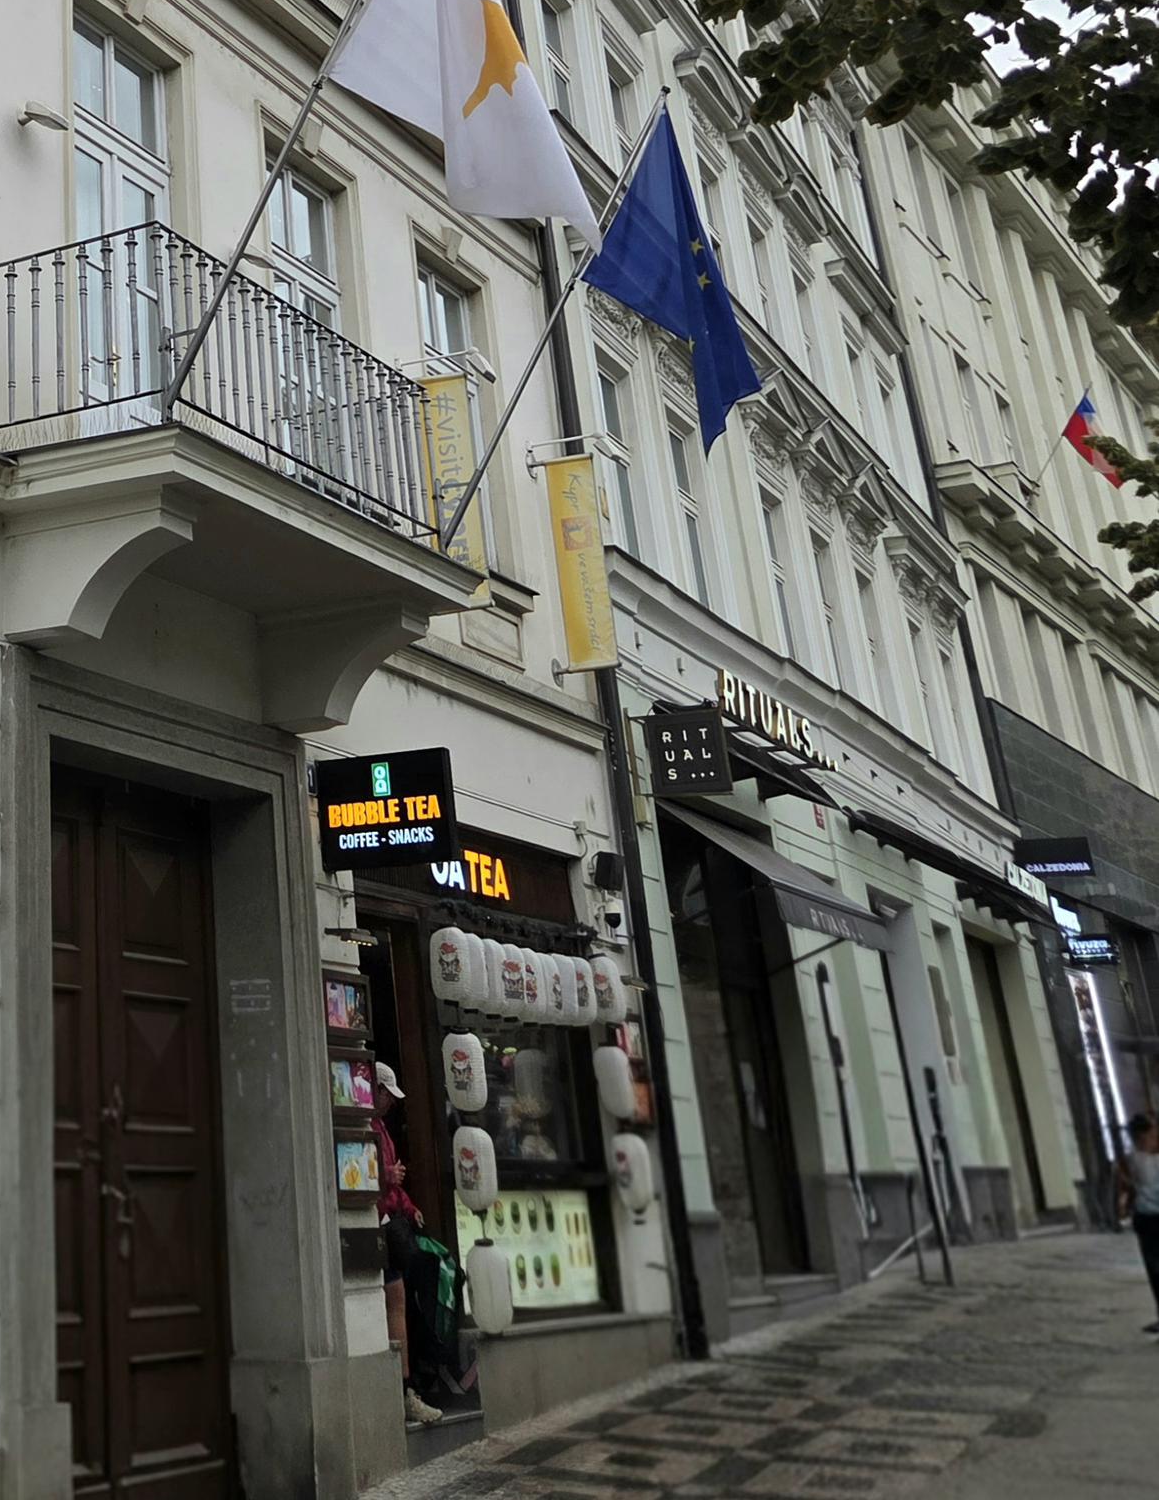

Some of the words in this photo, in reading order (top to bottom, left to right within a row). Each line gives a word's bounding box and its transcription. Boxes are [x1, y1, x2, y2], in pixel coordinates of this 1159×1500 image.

[328, 798, 400, 828] BUBBLE
[403, 794, 441, 821] TEA
[339, 832, 379, 849] COFFEE
[388, 826, 434, 845] SNACKS
[1026, 862, 1091, 873] CALZEDONIA
